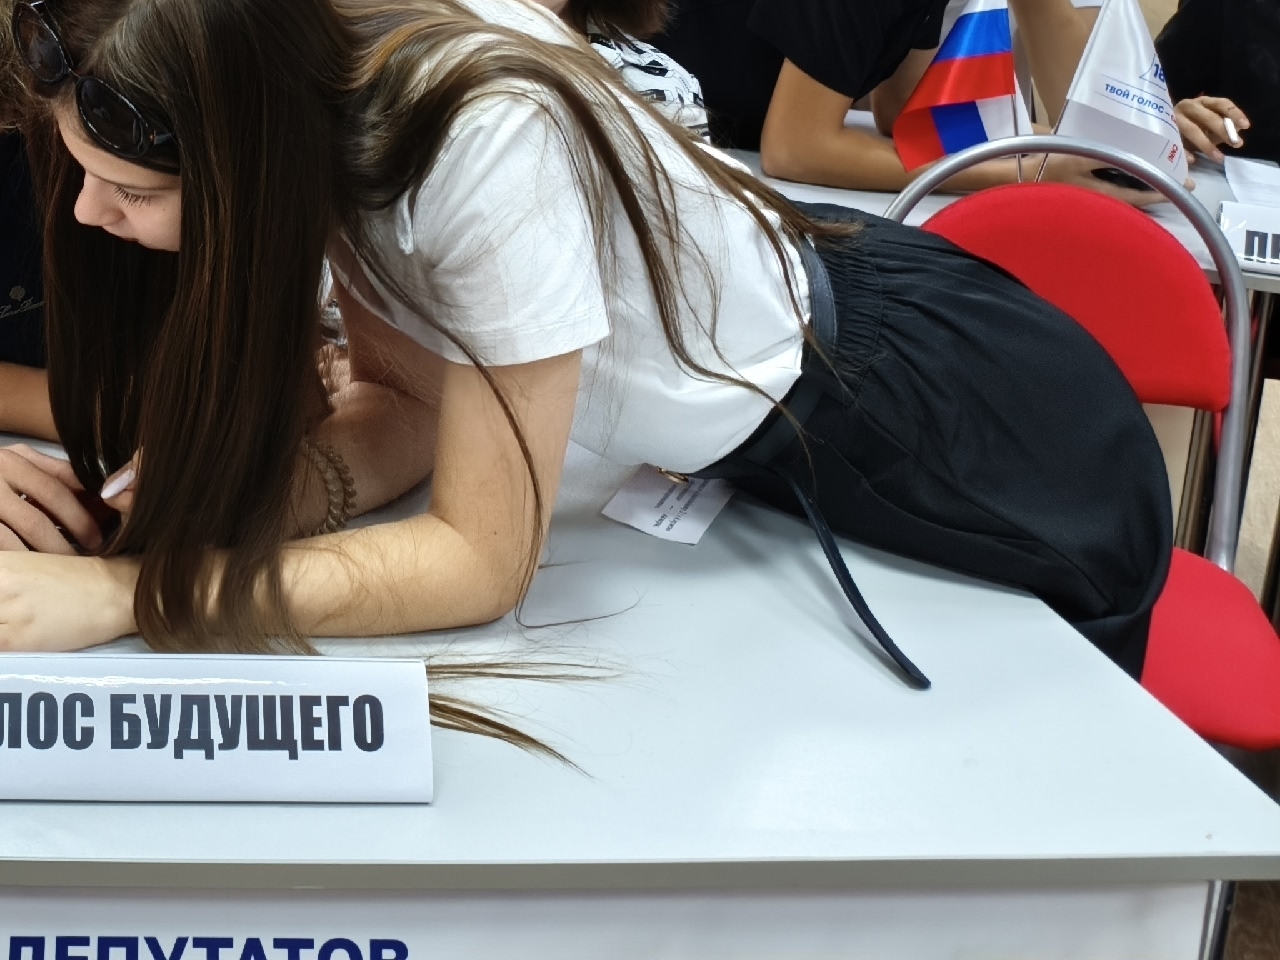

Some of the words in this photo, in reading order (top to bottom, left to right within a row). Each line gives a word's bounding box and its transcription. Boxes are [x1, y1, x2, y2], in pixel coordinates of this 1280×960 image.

[1105, 83, 1130, 100] ТВОЙ
[1131, 94, 1164, 114] ГОЛОС
[110, 693, 385, 761] БУДУЩЕГО
